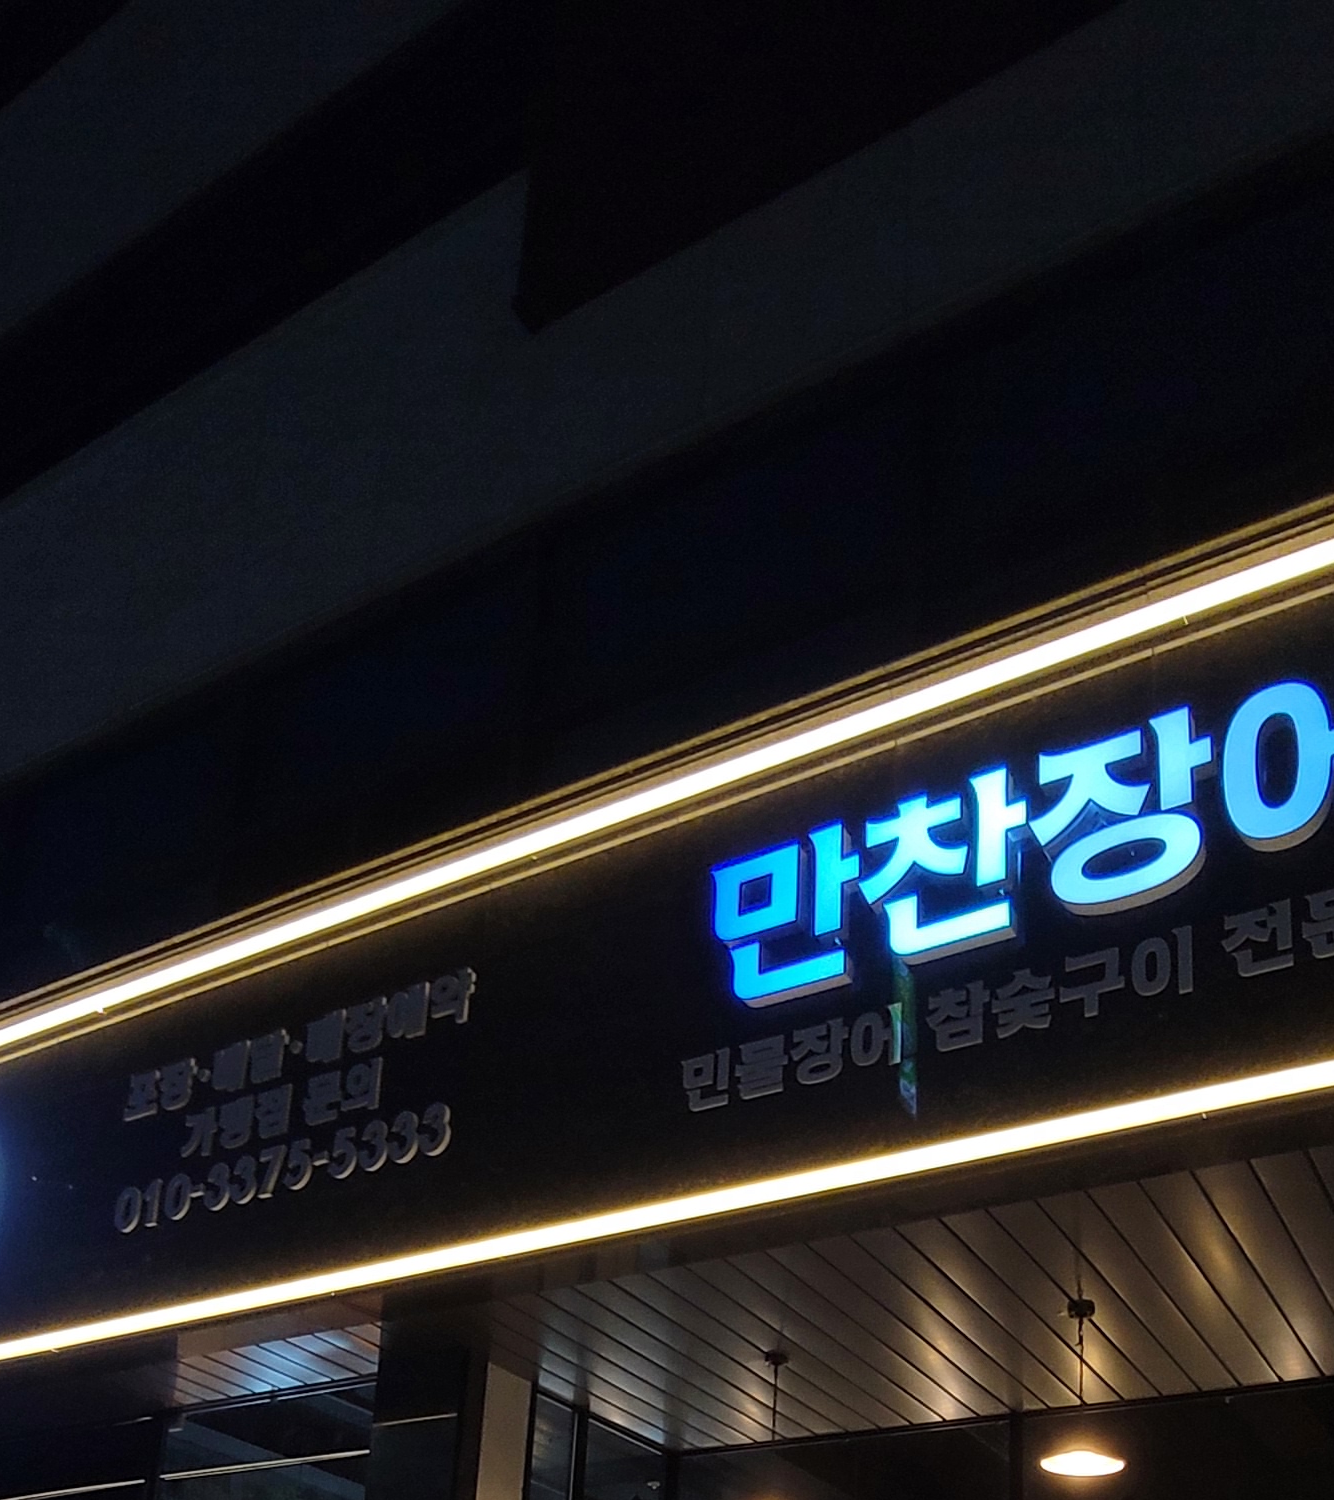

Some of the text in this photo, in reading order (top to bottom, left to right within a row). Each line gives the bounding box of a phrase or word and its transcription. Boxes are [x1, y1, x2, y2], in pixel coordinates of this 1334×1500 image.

[681, 1000, 904, 1112] 민물장어
[925, 925, 1195, 1053] 참숯구이
[303, 1056, 384, 1127] 문의
[114, 1102, 452, 1234] 010-3375-5333
